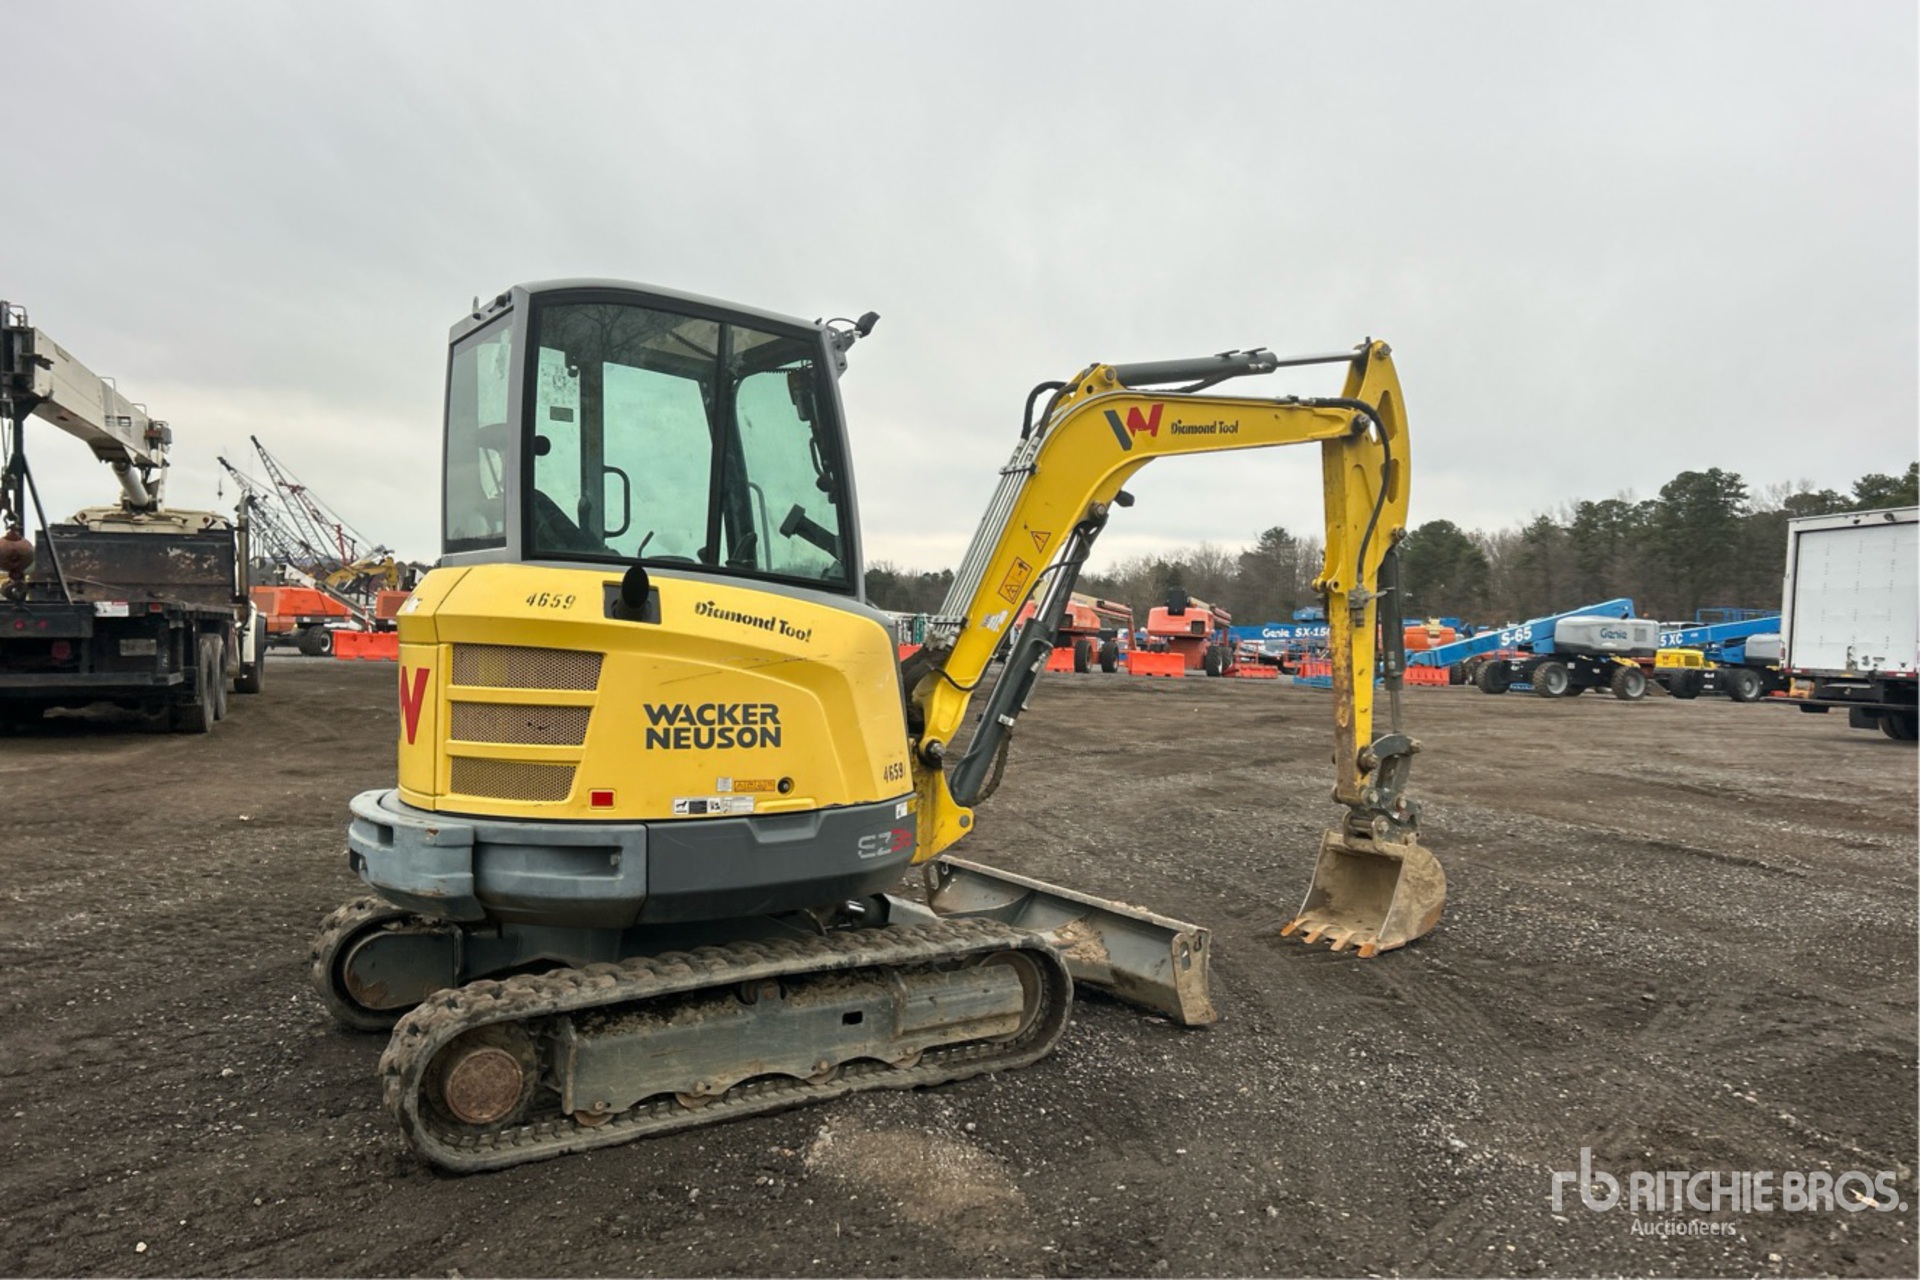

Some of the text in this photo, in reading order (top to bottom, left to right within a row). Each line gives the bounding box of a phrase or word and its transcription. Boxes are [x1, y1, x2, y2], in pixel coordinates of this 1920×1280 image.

[1171, 419, 1239, 435] Diamond Tool
[526, 593, 576, 609] 4659
[694, 600, 776, 632] Diamond
[1262, 628, 1290, 638] Genie
[1501, 626, 1532, 646] S-65
[1600, 628, 1628, 639] Genie
[1669, 633, 1683, 645] XC
[643, 703, 782, 726] WACKER
[646, 727, 782, 749] NEUSON
[883, 763, 904, 783] 4659
